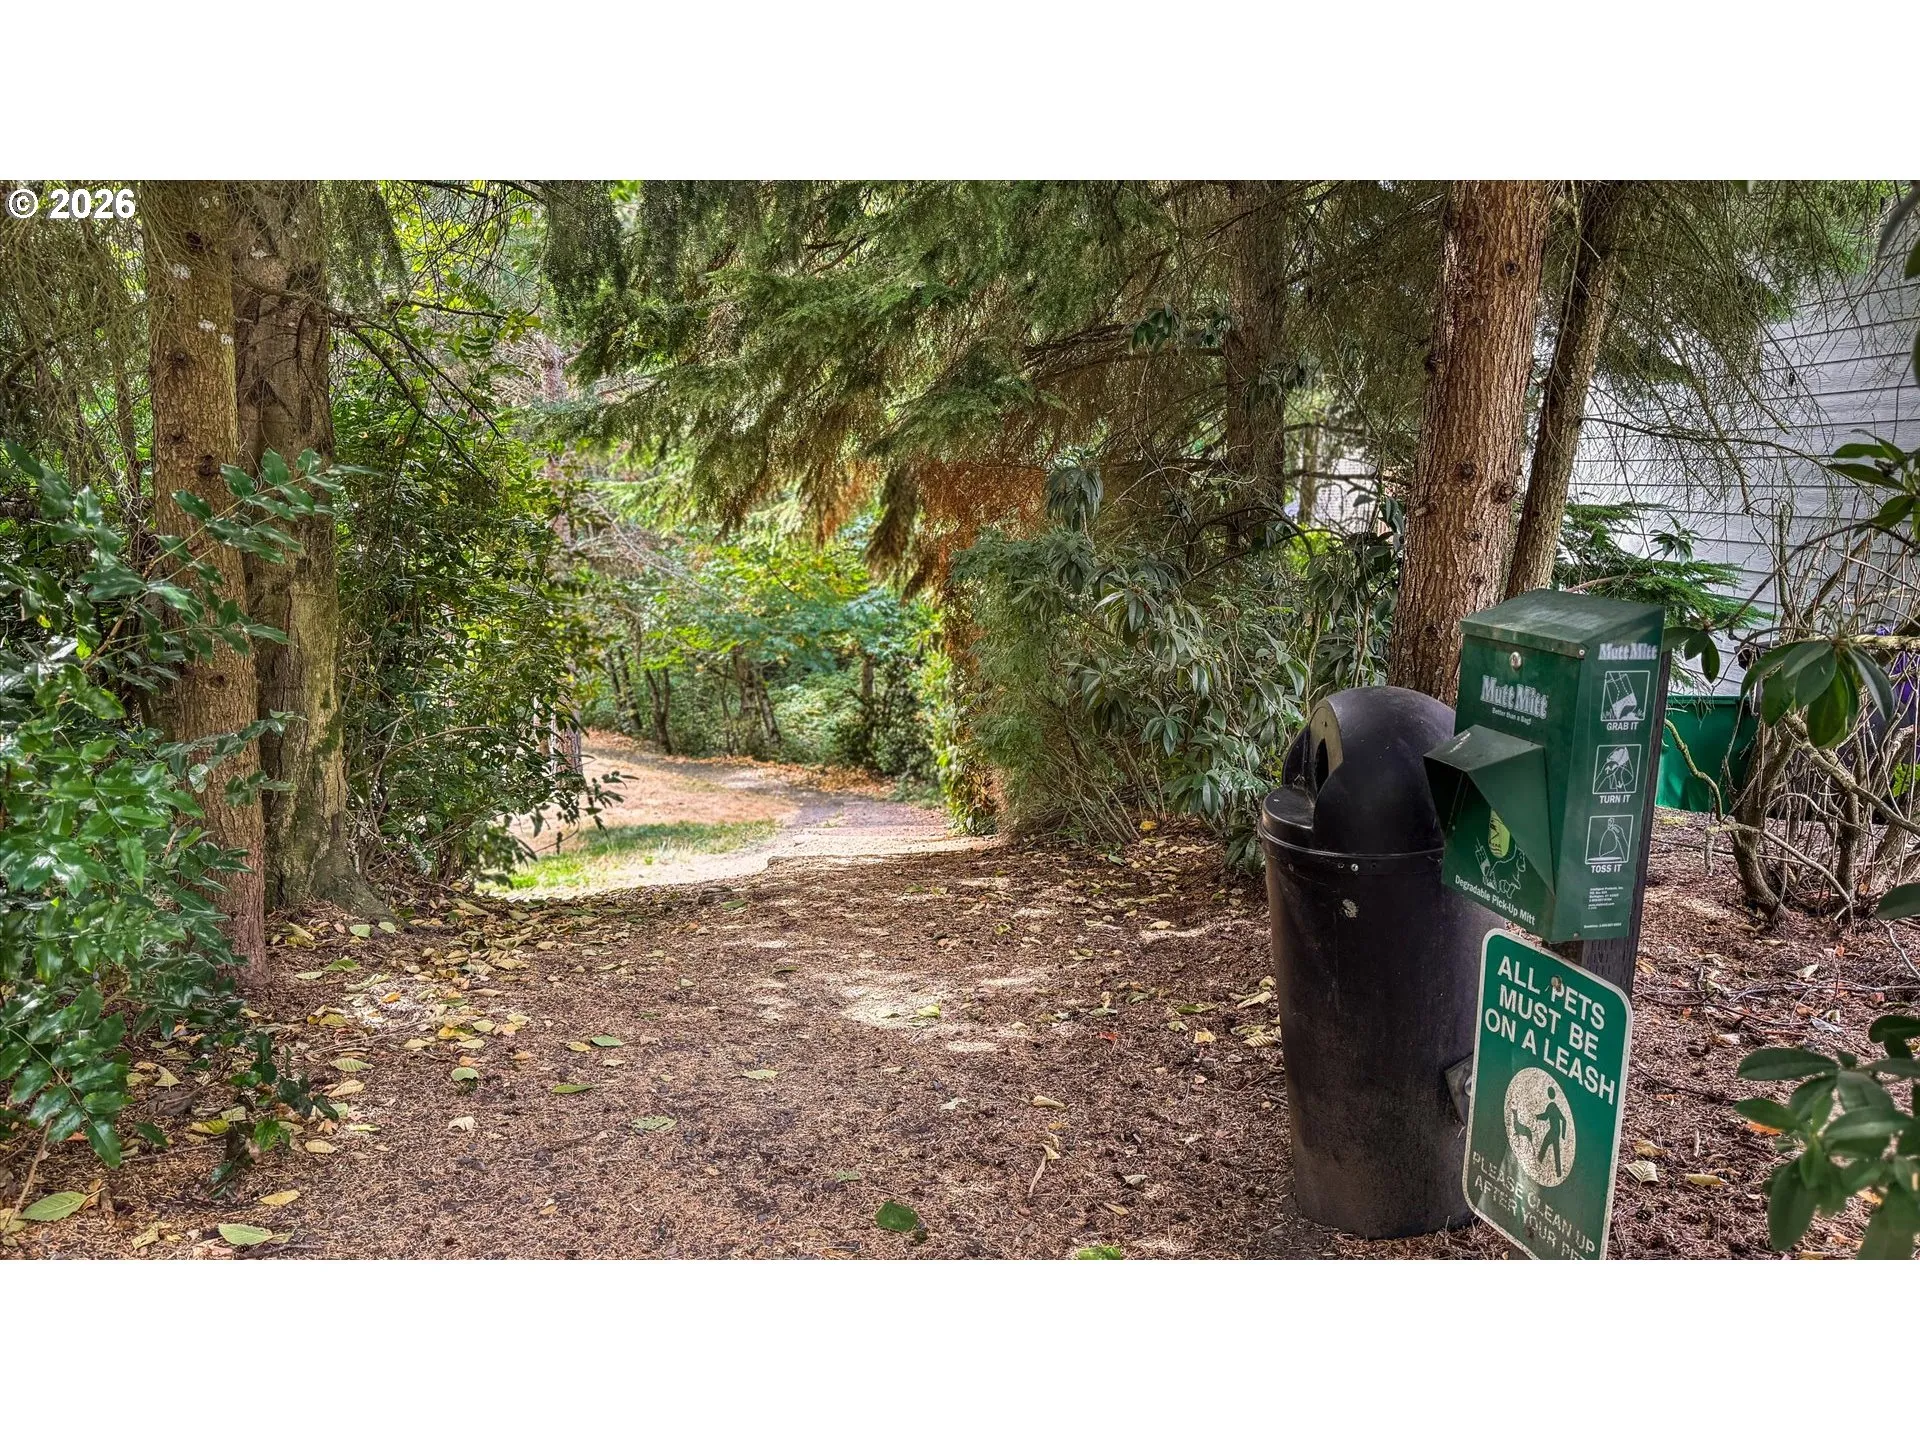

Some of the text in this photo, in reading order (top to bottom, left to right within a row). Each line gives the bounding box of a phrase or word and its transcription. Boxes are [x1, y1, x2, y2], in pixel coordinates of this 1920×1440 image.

[1598, 642, 1658, 660] Mutt Mitt
[1480, 675, 1548, 719] Mutt Mitt
[1606, 721, 1639, 731] GRAB IT
[1600, 794, 1631, 804] TURN IT
[1591, 863, 1622, 873] TOSS IT
[1455, 874, 1536, 926] Degradable Pick-Up Mitt
[1497, 955, 1605, 1030] ALL PETS
[1499, 984, 1599, 1061] MUST BE
[1485, 1008, 1615, 1106] ON A LEASH
[1472, 1151, 1596, 1254] PLEASE CLEAN UP
[1474, 1174, 1518, 1217] AFTER
[1521, 1206, 1557, 1248] YOUR
